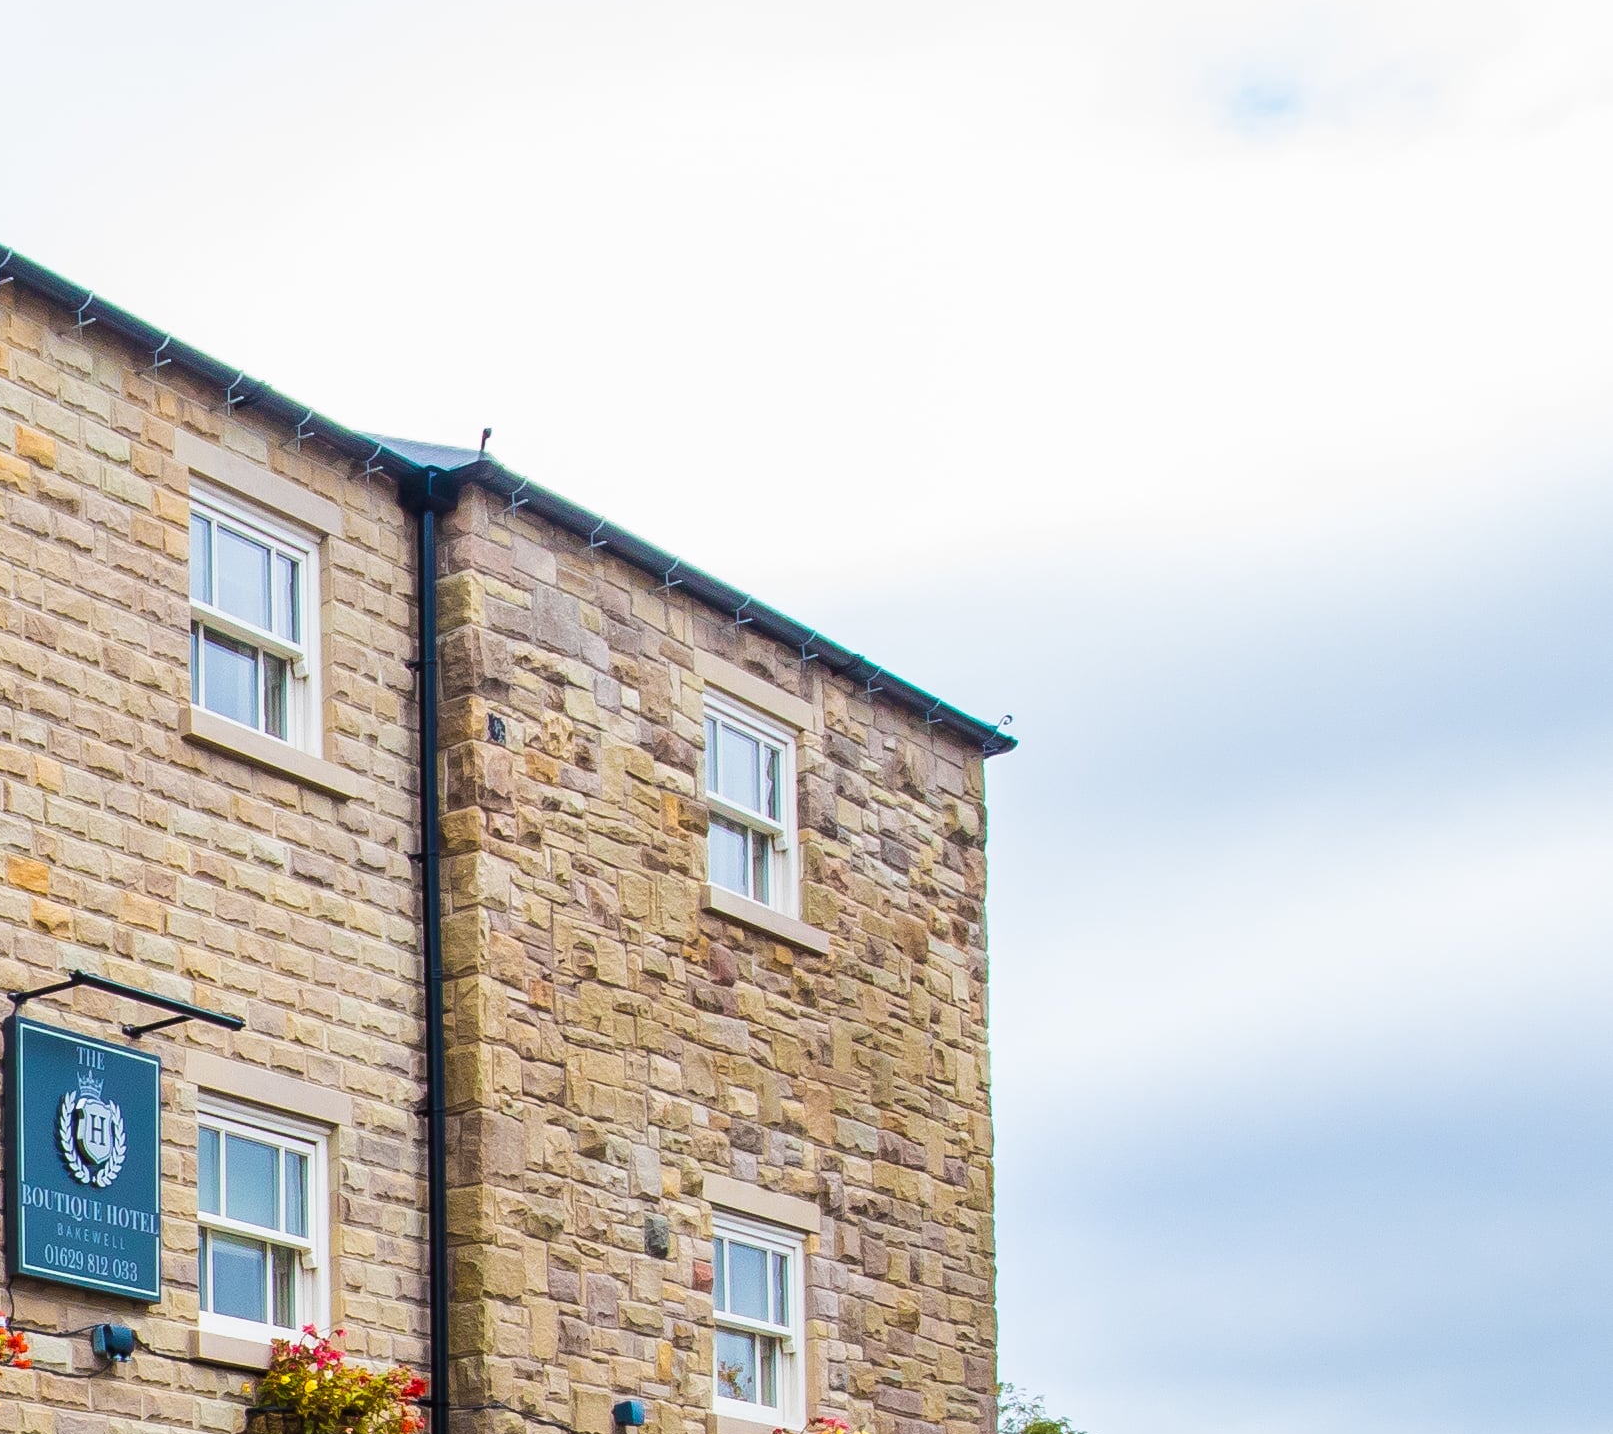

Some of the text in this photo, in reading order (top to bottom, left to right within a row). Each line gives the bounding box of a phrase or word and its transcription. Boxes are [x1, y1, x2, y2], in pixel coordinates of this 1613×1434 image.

[76, 1046, 105, 1071] THE
[89, 1115, 106, 1146] H
[22, 1184, 159, 1235] BOUTIQUE HOTEL
[57, 1223, 125, 1250] BAKEWELL
[45, 1244, 137, 1282] 01629 812 033
